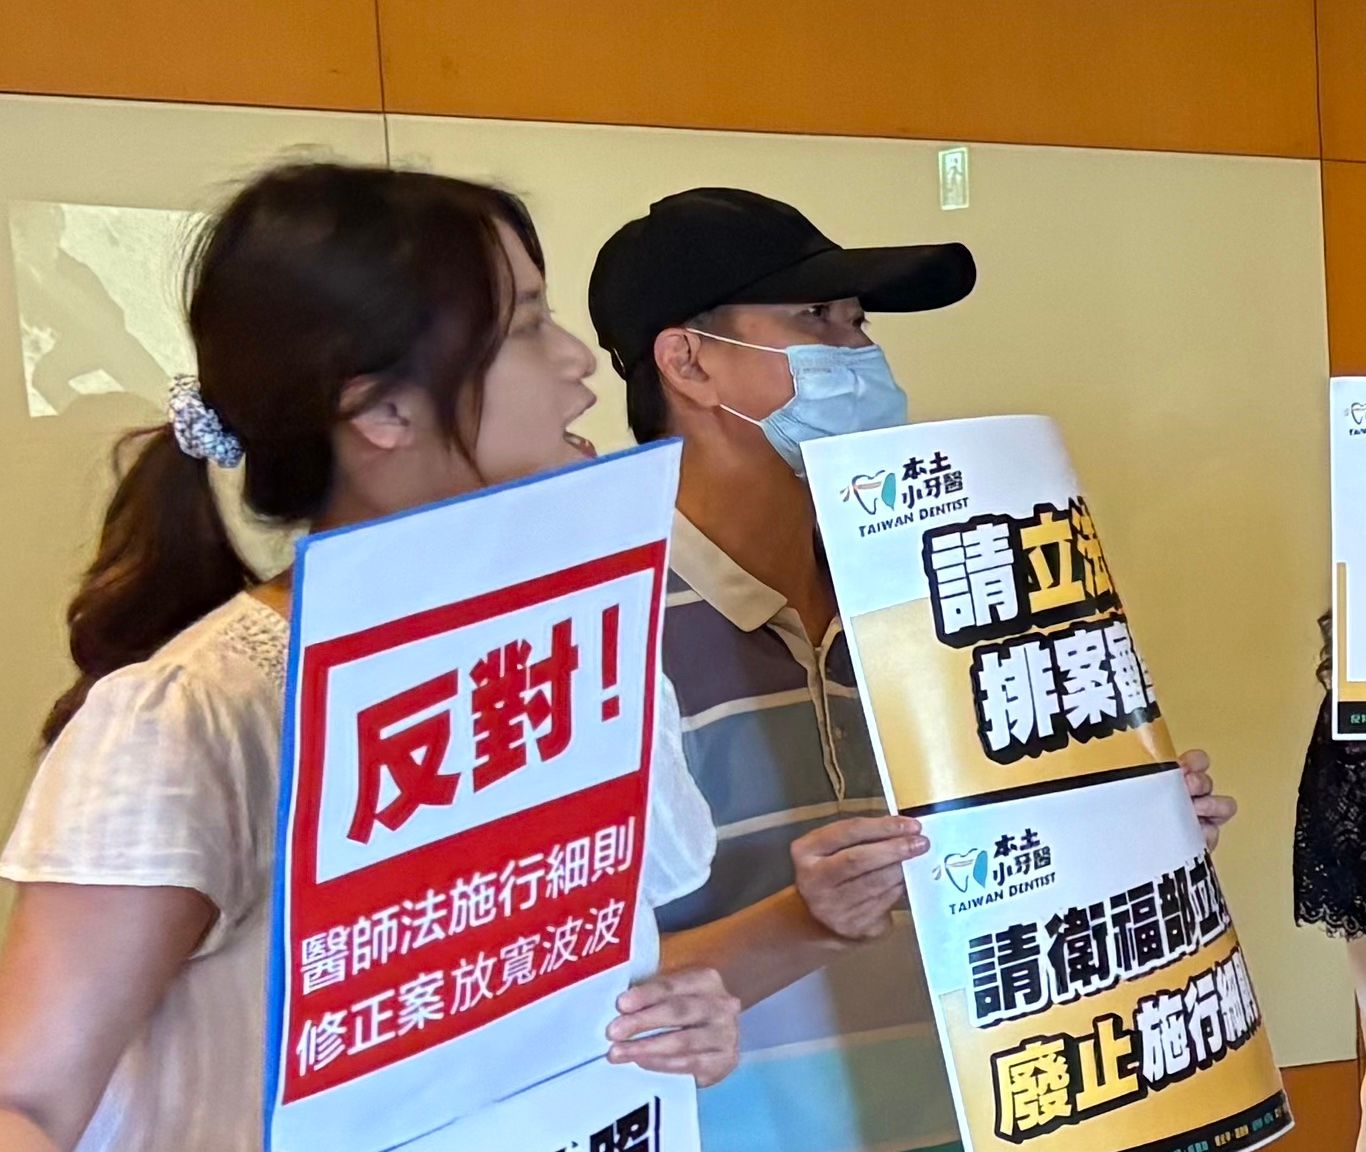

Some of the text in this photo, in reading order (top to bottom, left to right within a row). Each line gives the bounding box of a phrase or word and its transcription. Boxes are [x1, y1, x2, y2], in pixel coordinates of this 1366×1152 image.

[901, 451, 952, 481] 本土
[901, 469, 964, 510] 小牙醫
[858, 496, 969, 538] TAIWAN DENTIST
[975, 618, 1160, 757] 排案審
[347, 604, 621, 846] 反對!
[993, 828, 1041, 859] 本土
[299, 815, 636, 995] 醫師法施行細則
[949, 871, 1056, 916] TAIWAN DENTIST
[294, 897, 623, 1078] 修正案放寬波波
